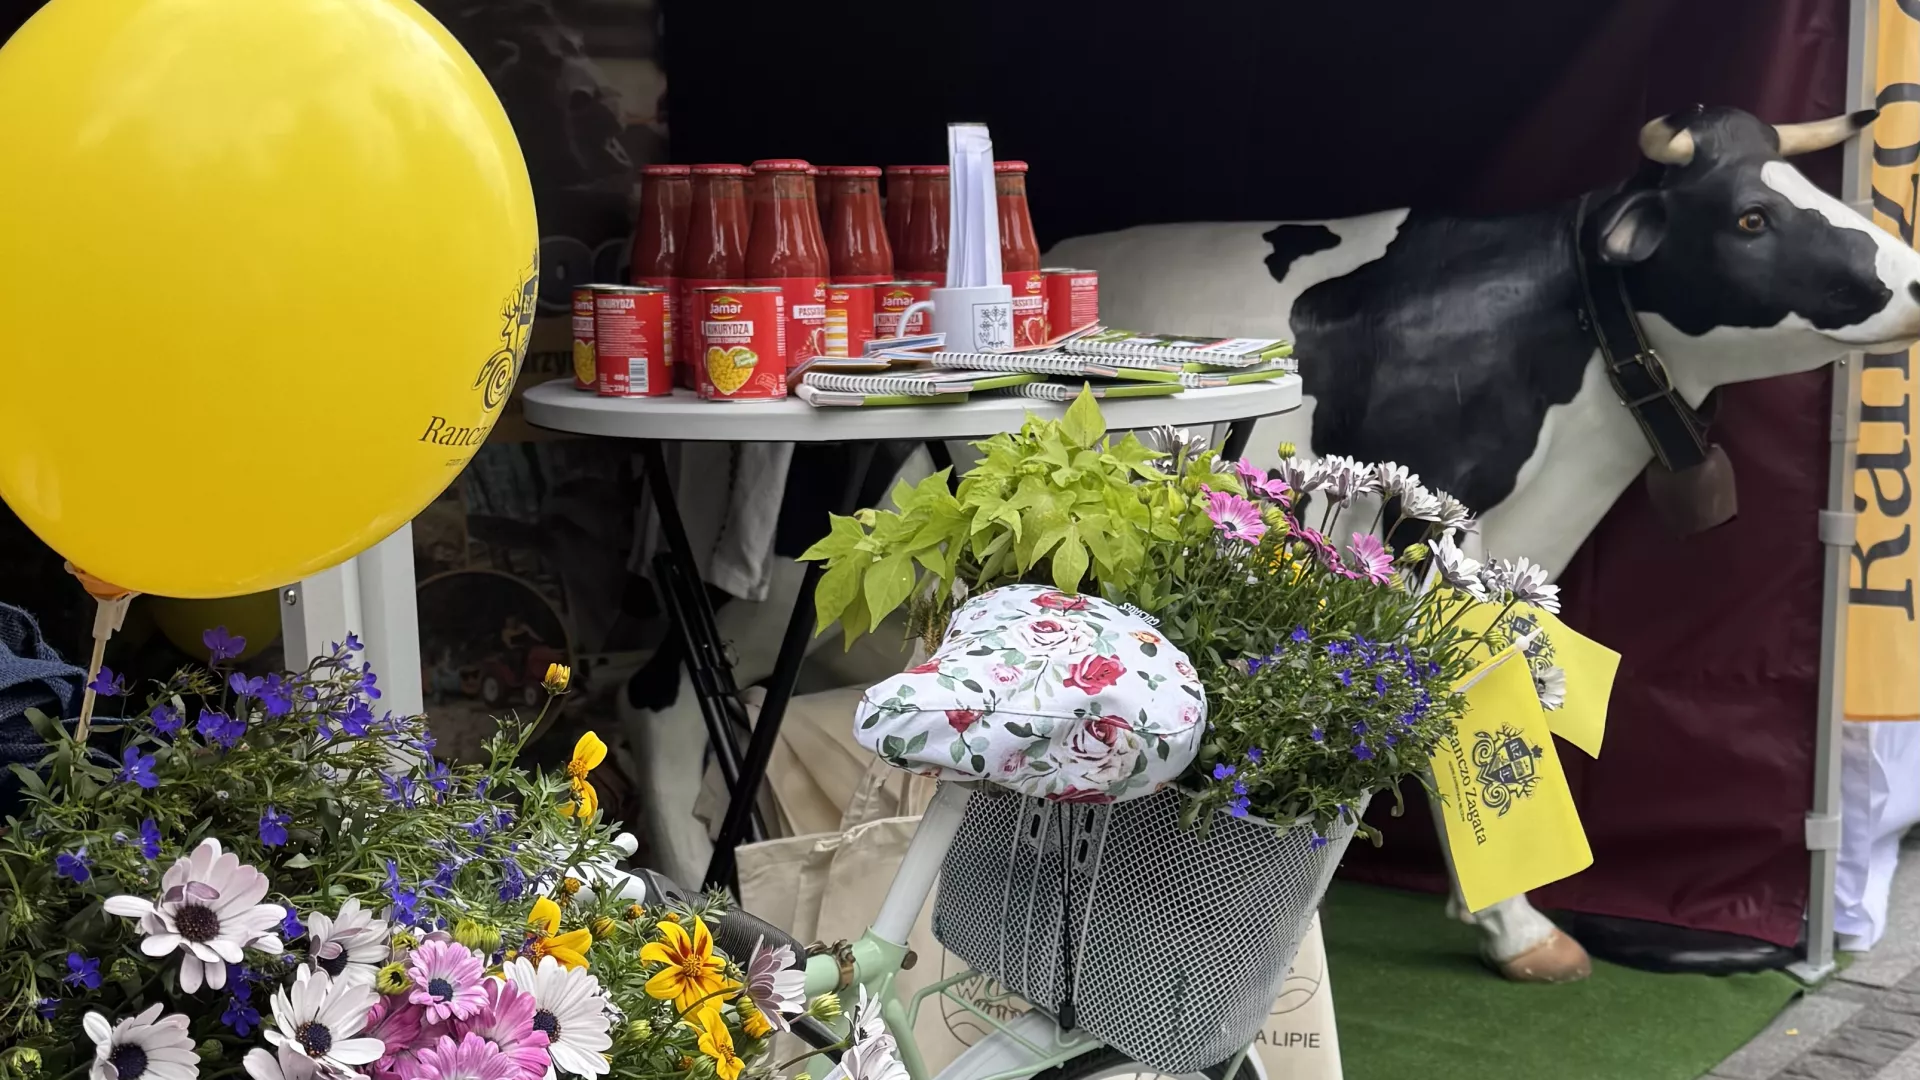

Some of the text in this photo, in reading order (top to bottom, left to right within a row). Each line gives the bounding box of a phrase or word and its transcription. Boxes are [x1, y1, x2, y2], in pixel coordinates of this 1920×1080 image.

[709, 303, 744, 315] Jamar
[1848, 82, 1920, 621] Ranzo
[1465, 787, 1487, 846] Zagata
[1272, 1030, 1321, 1049] LIPIE
